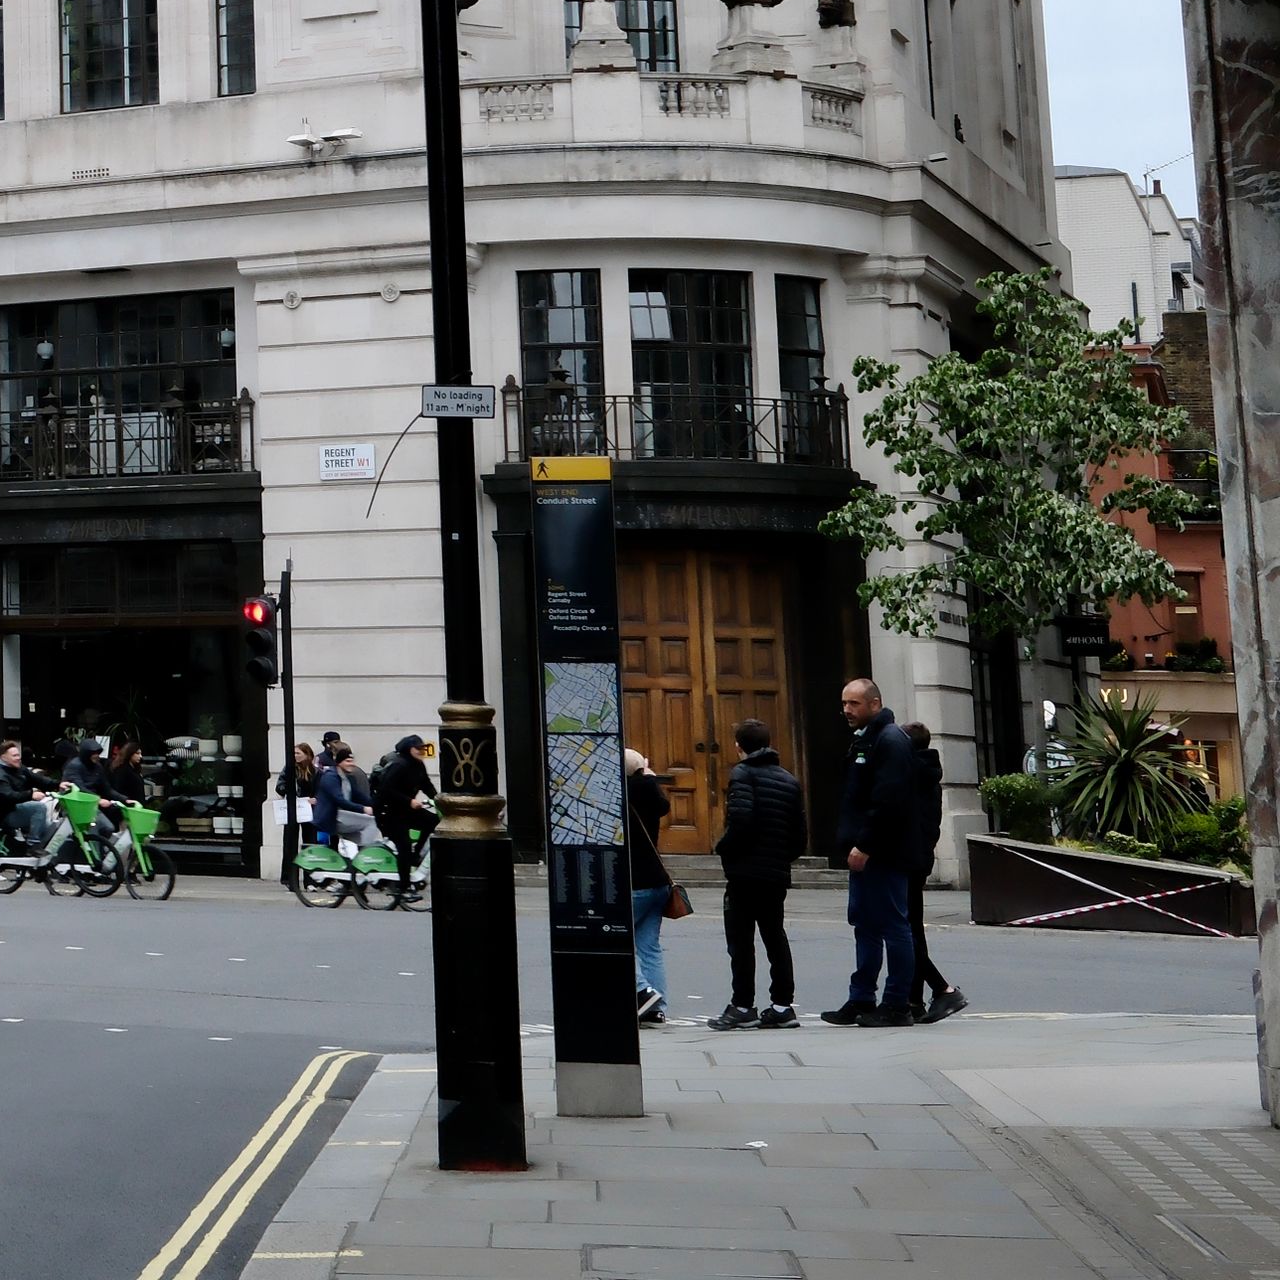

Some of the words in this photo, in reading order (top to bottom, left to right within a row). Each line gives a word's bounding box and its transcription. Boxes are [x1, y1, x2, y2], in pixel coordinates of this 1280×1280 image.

[433, 391, 447, 400] No
[449, 391, 483, 402] loading
[456, 403, 490, 414] M'night
[324, 448, 356, 458] REGENT
[324, 459, 355, 468] STREET
[356, 458, 370, 467] W1
[536, 497, 569, 505] Conduit
[570, 497, 597, 505] Street
